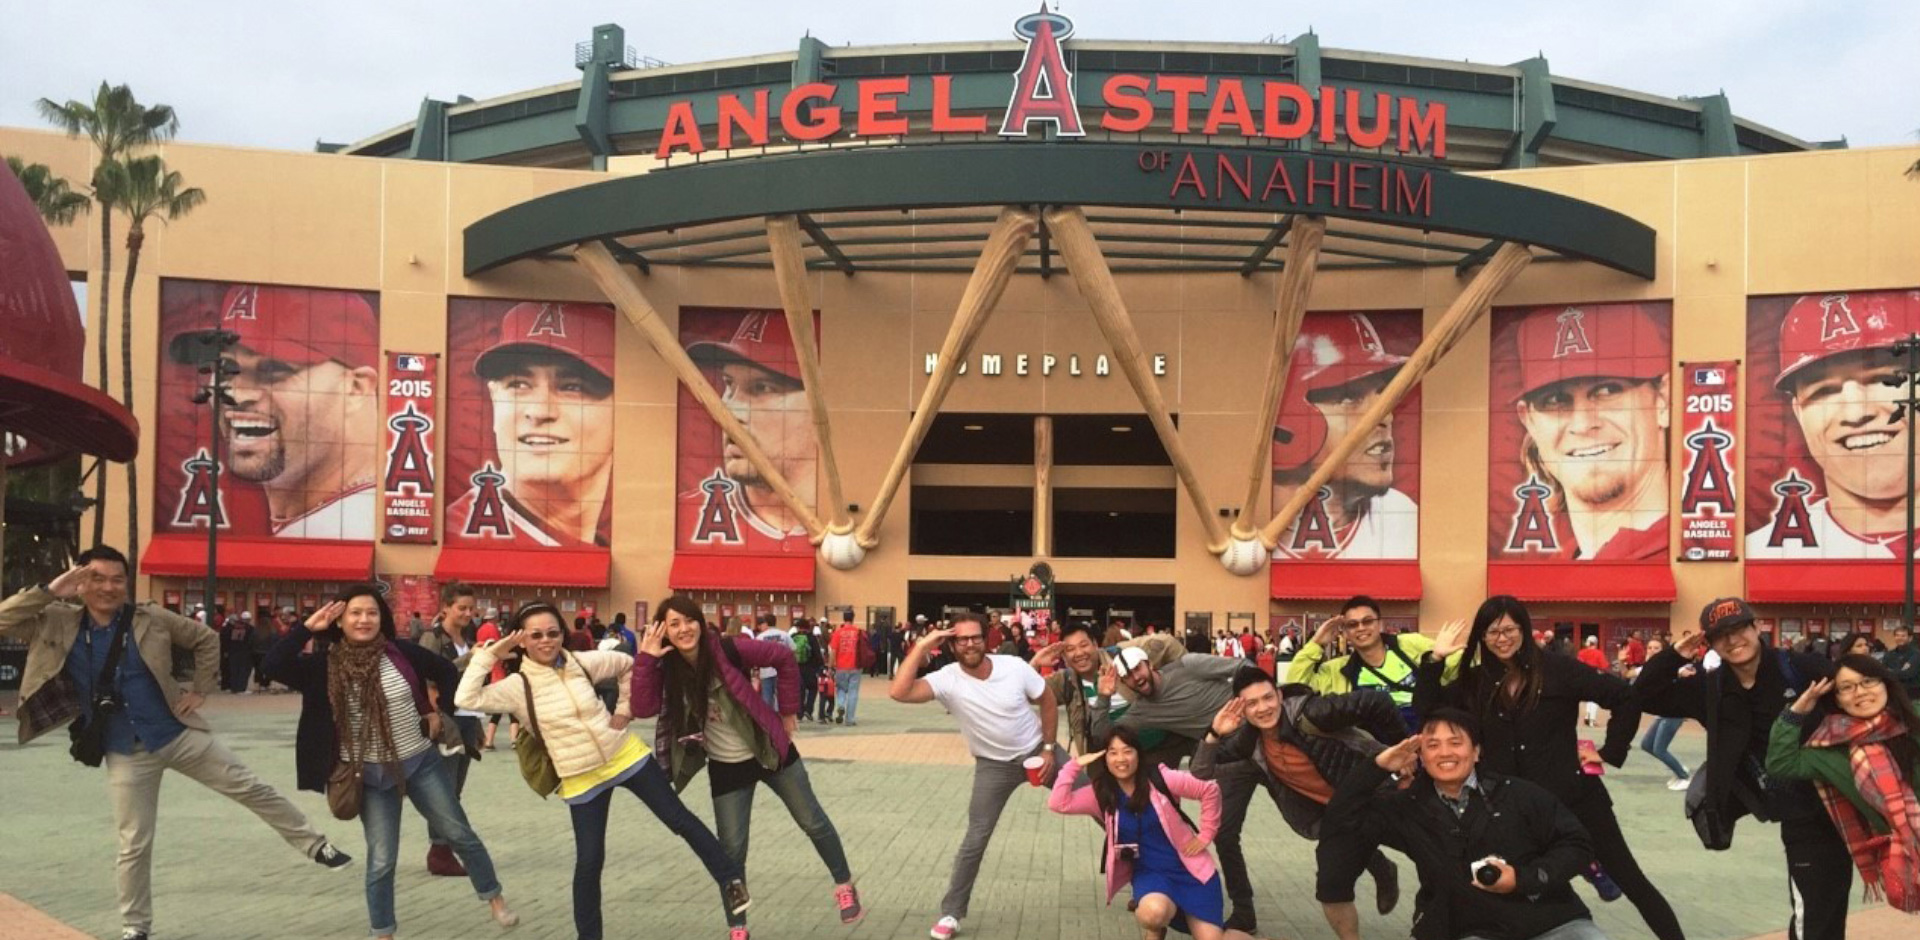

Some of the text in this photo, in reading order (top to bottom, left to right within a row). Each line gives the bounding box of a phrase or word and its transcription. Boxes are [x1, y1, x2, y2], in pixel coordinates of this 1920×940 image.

[998, 0, 1086, 136] A
[655, 73, 1448, 160] ANGEL STADIUM
[1138, 150, 1432, 218] OF ANAHEIM
[926, 353, 1165, 375] HMEPLAE
[389, 379, 432, 397] 2015
[1686, 394, 1733, 413] 2015
[386, 507, 431, 516] BASEBALL
[391, 499, 427, 507] ANGELS
[1689, 520, 1728, 529] ANGELS
[1683, 530, 1732, 538] BASEBALL
[1706, 549, 1731, 557] WEST
